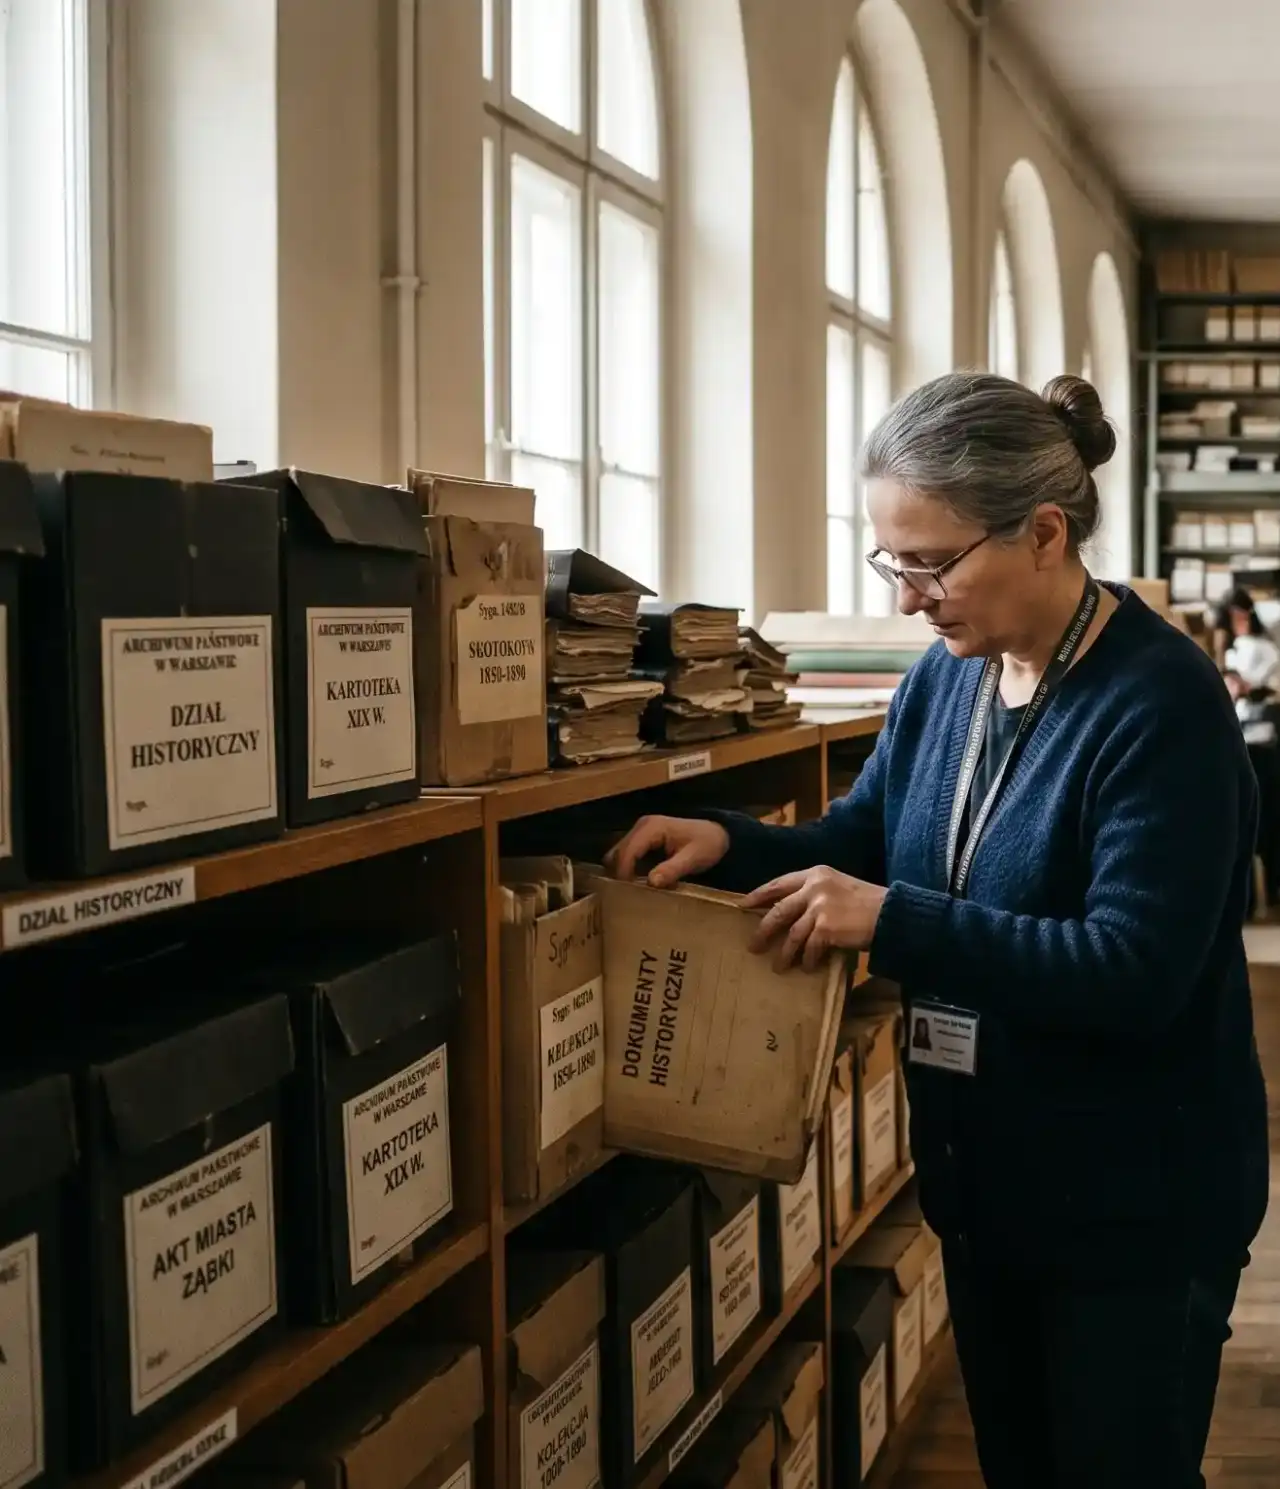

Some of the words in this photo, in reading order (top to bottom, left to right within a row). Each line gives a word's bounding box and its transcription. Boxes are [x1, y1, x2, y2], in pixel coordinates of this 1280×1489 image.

[326, 677, 401, 702] KARTOTEKA
[347, 708, 372, 730] XIX
[131, 729, 261, 769] HISTORYCZNY
[74, 876, 184, 922] HISTORYCZNY
[620, 950, 659, 1079] DOKUMENTY
[648, 947, 688, 1088] HISTORYCZNE
[362, 1111, 439, 1177] KARTOTEKA
[383, 1161, 409, 1197] XIX
[409, 1151, 425, 1175] W.
[152, 1237, 190, 1282] AKT
[195, 1201, 256, 1255] MIASTA
[181, 1248, 235, 1300] ZĄBKI
